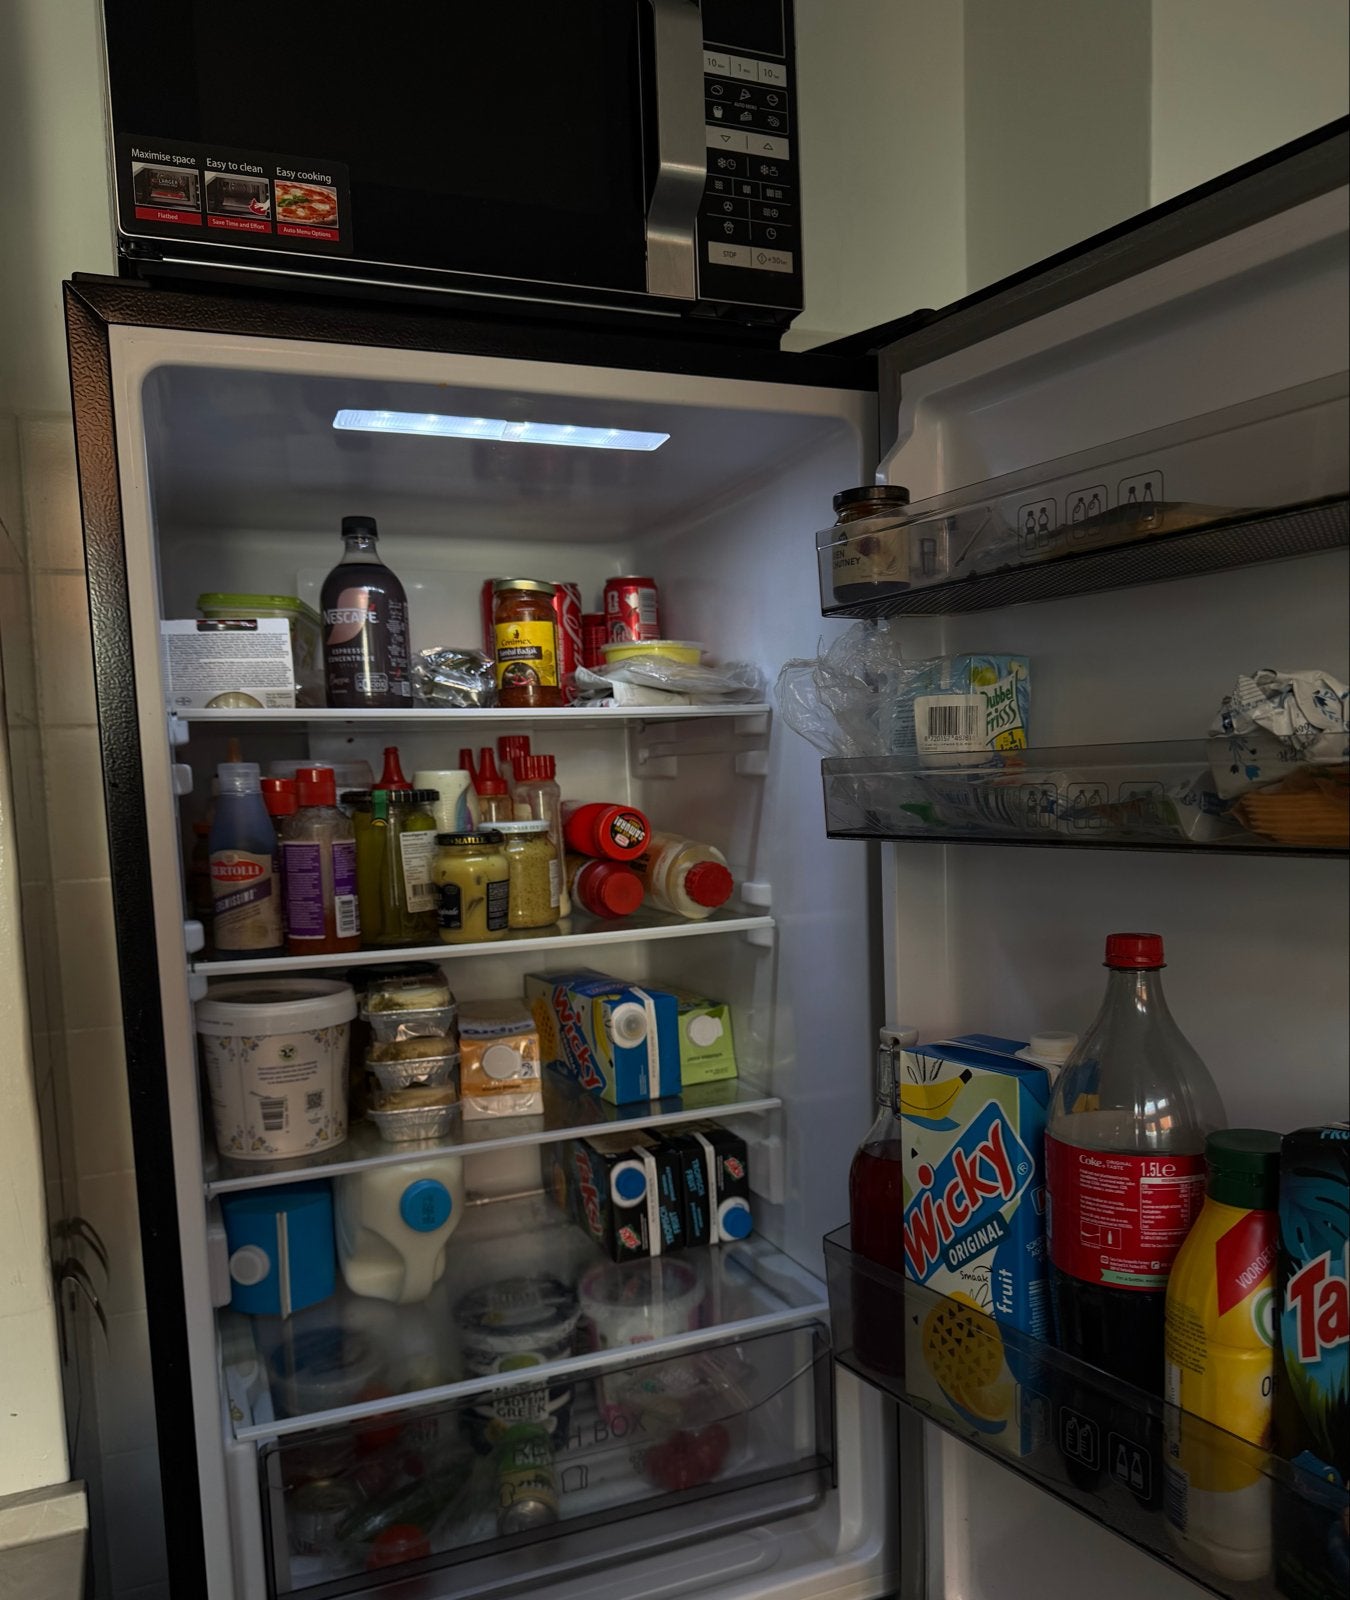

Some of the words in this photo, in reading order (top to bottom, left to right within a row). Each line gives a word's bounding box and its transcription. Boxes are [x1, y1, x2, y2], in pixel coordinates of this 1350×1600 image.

[131, 148, 171, 162] Maximise
[172, 155, 196, 165] space
[206, 158, 226, 171] Easy
[228, 161, 238, 170] to
[239, 163, 263, 174] clean
[276, 167, 296, 180] Easy
[297, 172, 332, 185] cooking
[157, 212, 179, 220] Flatbed
[226, 219, 239, 227] Time
[311, 230, 332, 238] Options
[553, 983, 605, 1089] Wicky
[903, 1119, 1016, 1279] Wicky
[948, 1223, 1004, 1266] ORIGINAL
[996, 1268, 1013, 1315] fruit
